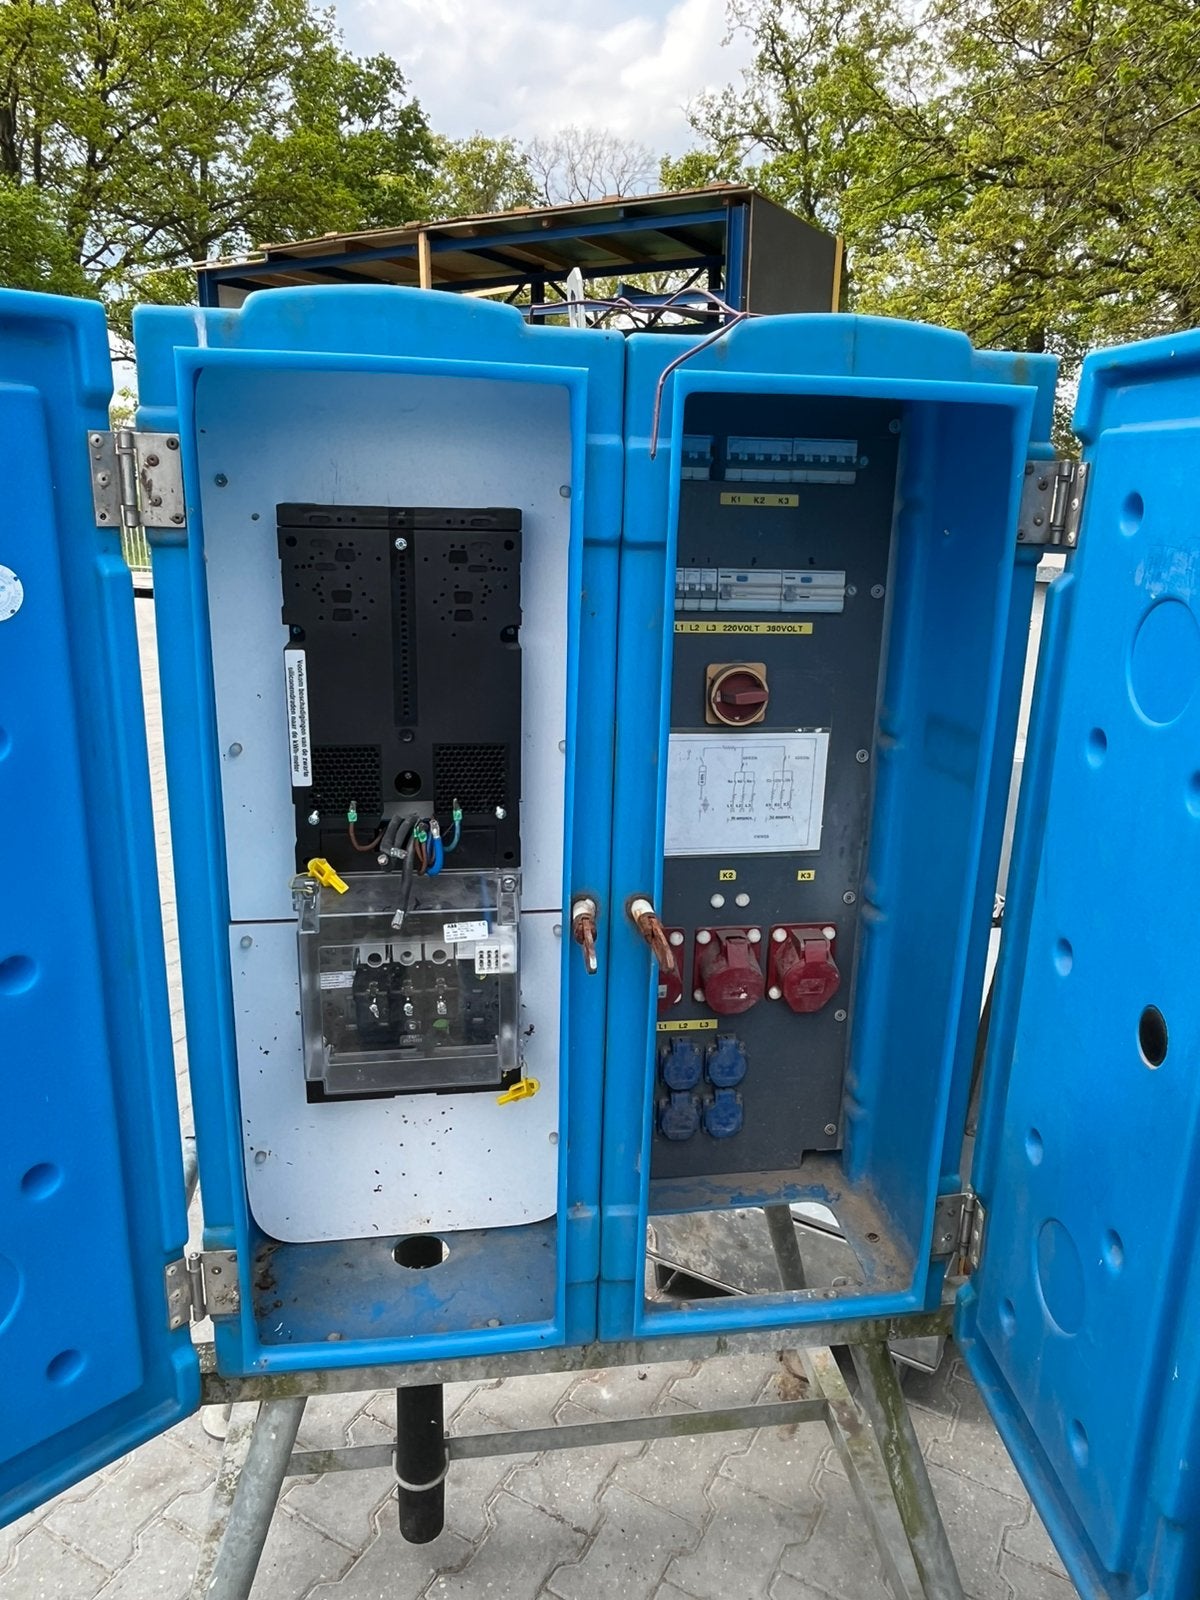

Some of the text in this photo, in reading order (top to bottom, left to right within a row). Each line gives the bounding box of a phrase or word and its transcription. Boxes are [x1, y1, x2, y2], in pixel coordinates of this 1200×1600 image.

[731, 496, 790, 505] K1 K2 K3
[706, 624, 717, 632] L3
[722, 624, 760, 632] 220VOLT
[766, 625, 803, 633] 380VOLT
[288, 667, 296, 715] siliconendraden
[302, 748, 308, 756] de
